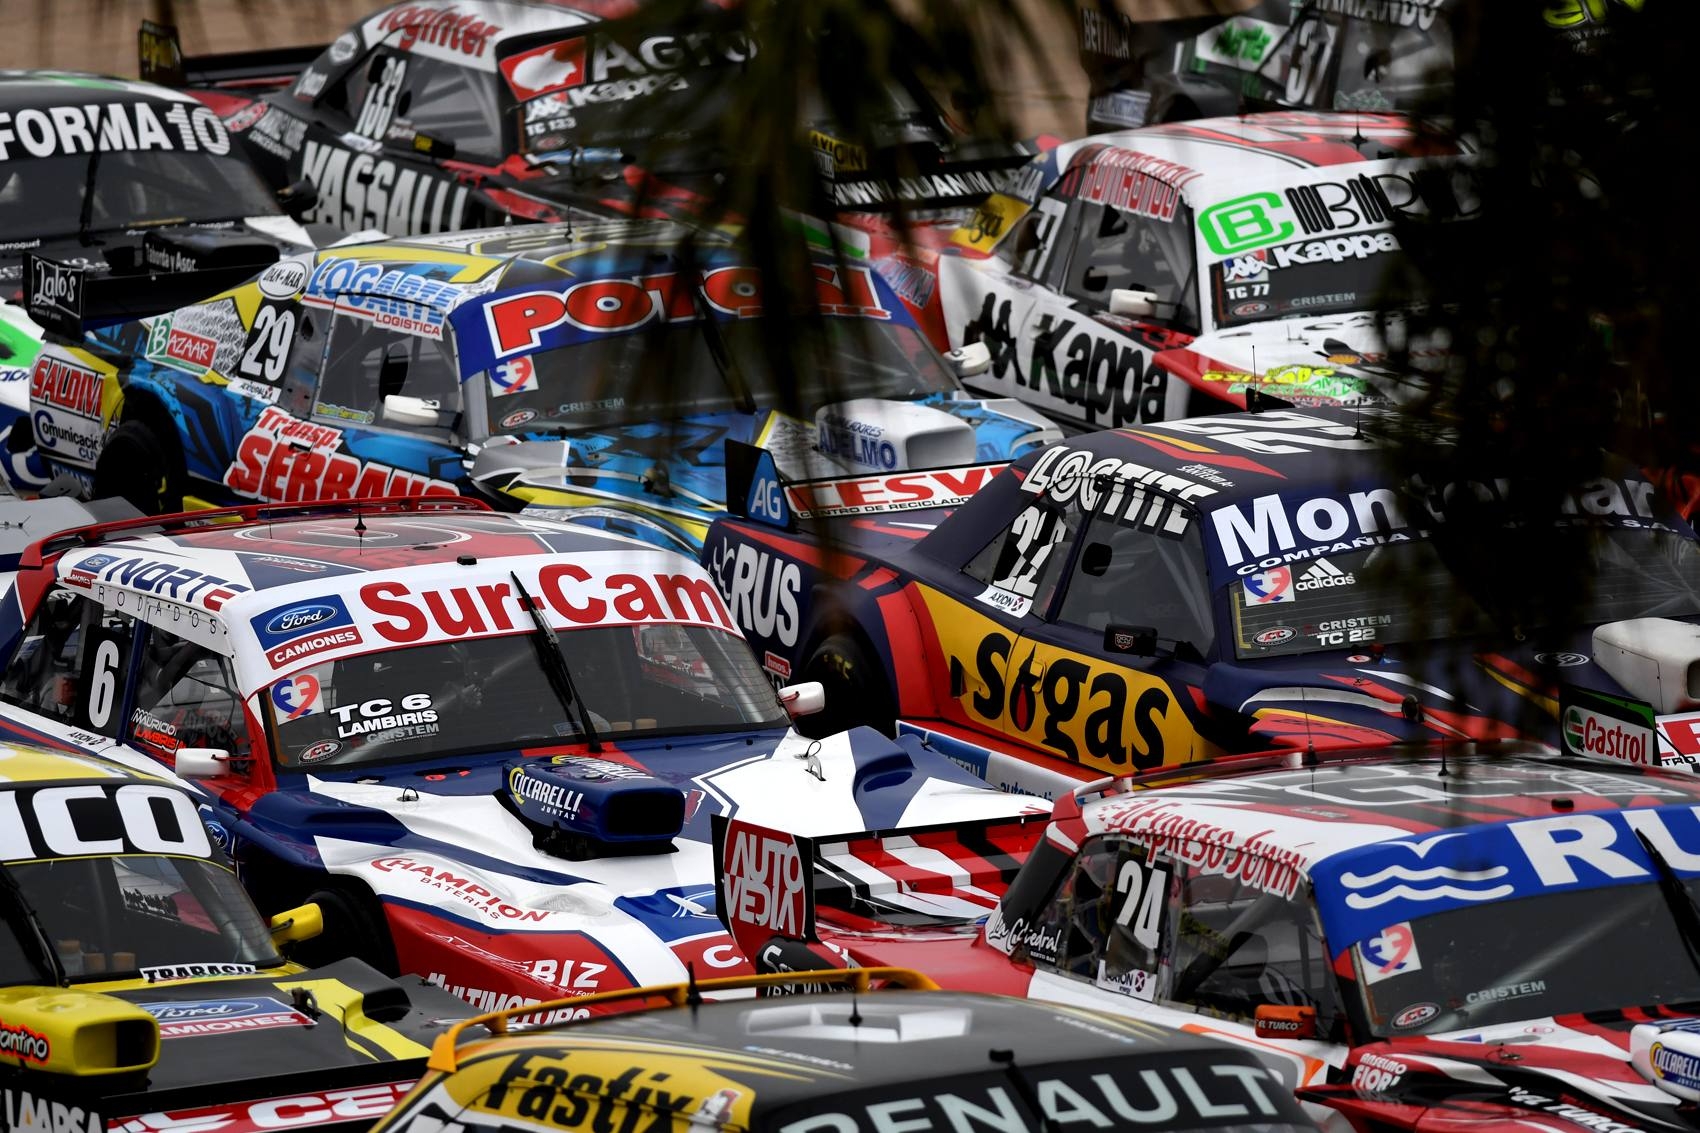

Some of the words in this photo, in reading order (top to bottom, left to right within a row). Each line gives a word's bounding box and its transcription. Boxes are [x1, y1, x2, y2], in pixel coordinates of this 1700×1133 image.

[1273, 231, 1400, 268] Kappa
[1226, 287, 1247, 300] TC
[1251, 284, 1270, 297] 77
[1291, 292, 1356, 307] CRISTEM
[240, 304, 295, 382] 29
[375, 313, 441, 337] LOGISTICA
[1029, 313, 1169, 429] Kappa
[258, 408, 337, 450] Transp.
[227, 434, 461, 501] SERRAN
[750, 478, 781, 520] AG
[864, 500, 884, 512] DE
[1020, 446, 1219, 535] LOCTITE
[105, 558, 251, 613] NORTE
[730, 542, 801, 648] RUS
[1295, 573, 1357, 592] adidas
[280, 610, 324, 630] Ford
[359, 563, 734, 643] Sur-Cam
[1317, 631, 1343, 646] TC
[1349, 628, 1376, 643] 22
[1319, 615, 1391, 632] CRISTEM
[273, 632, 357, 664] CAMIONES
[89, 639, 120, 729] 6
[330, 699, 393, 723] TC
[401, 693, 432, 710] 6
[338, 709, 439, 738] LAMBIRIS
[367, 723, 440, 744] CRISTEM
[1585, 716, 1648, 765] Castrol
[509, 767, 584, 813] CICCARELLI
[541, 805, 576, 821] JUNTAS
[729, 831, 802, 883] AUTO
[371, 857, 551, 922] CHAMPION
[420, 877, 501, 920] BATERIAS
[724, 873, 796, 935] VEDIA
[1107, 859, 1167, 950] 24
[1466, 980, 1546, 1003] CRISTEM
[159, 1014, 296, 1036] AMIONES
[1360, 1052, 1408, 1075] ANSELMO
[1650, 1041, 1700, 1080] CICCARELL
